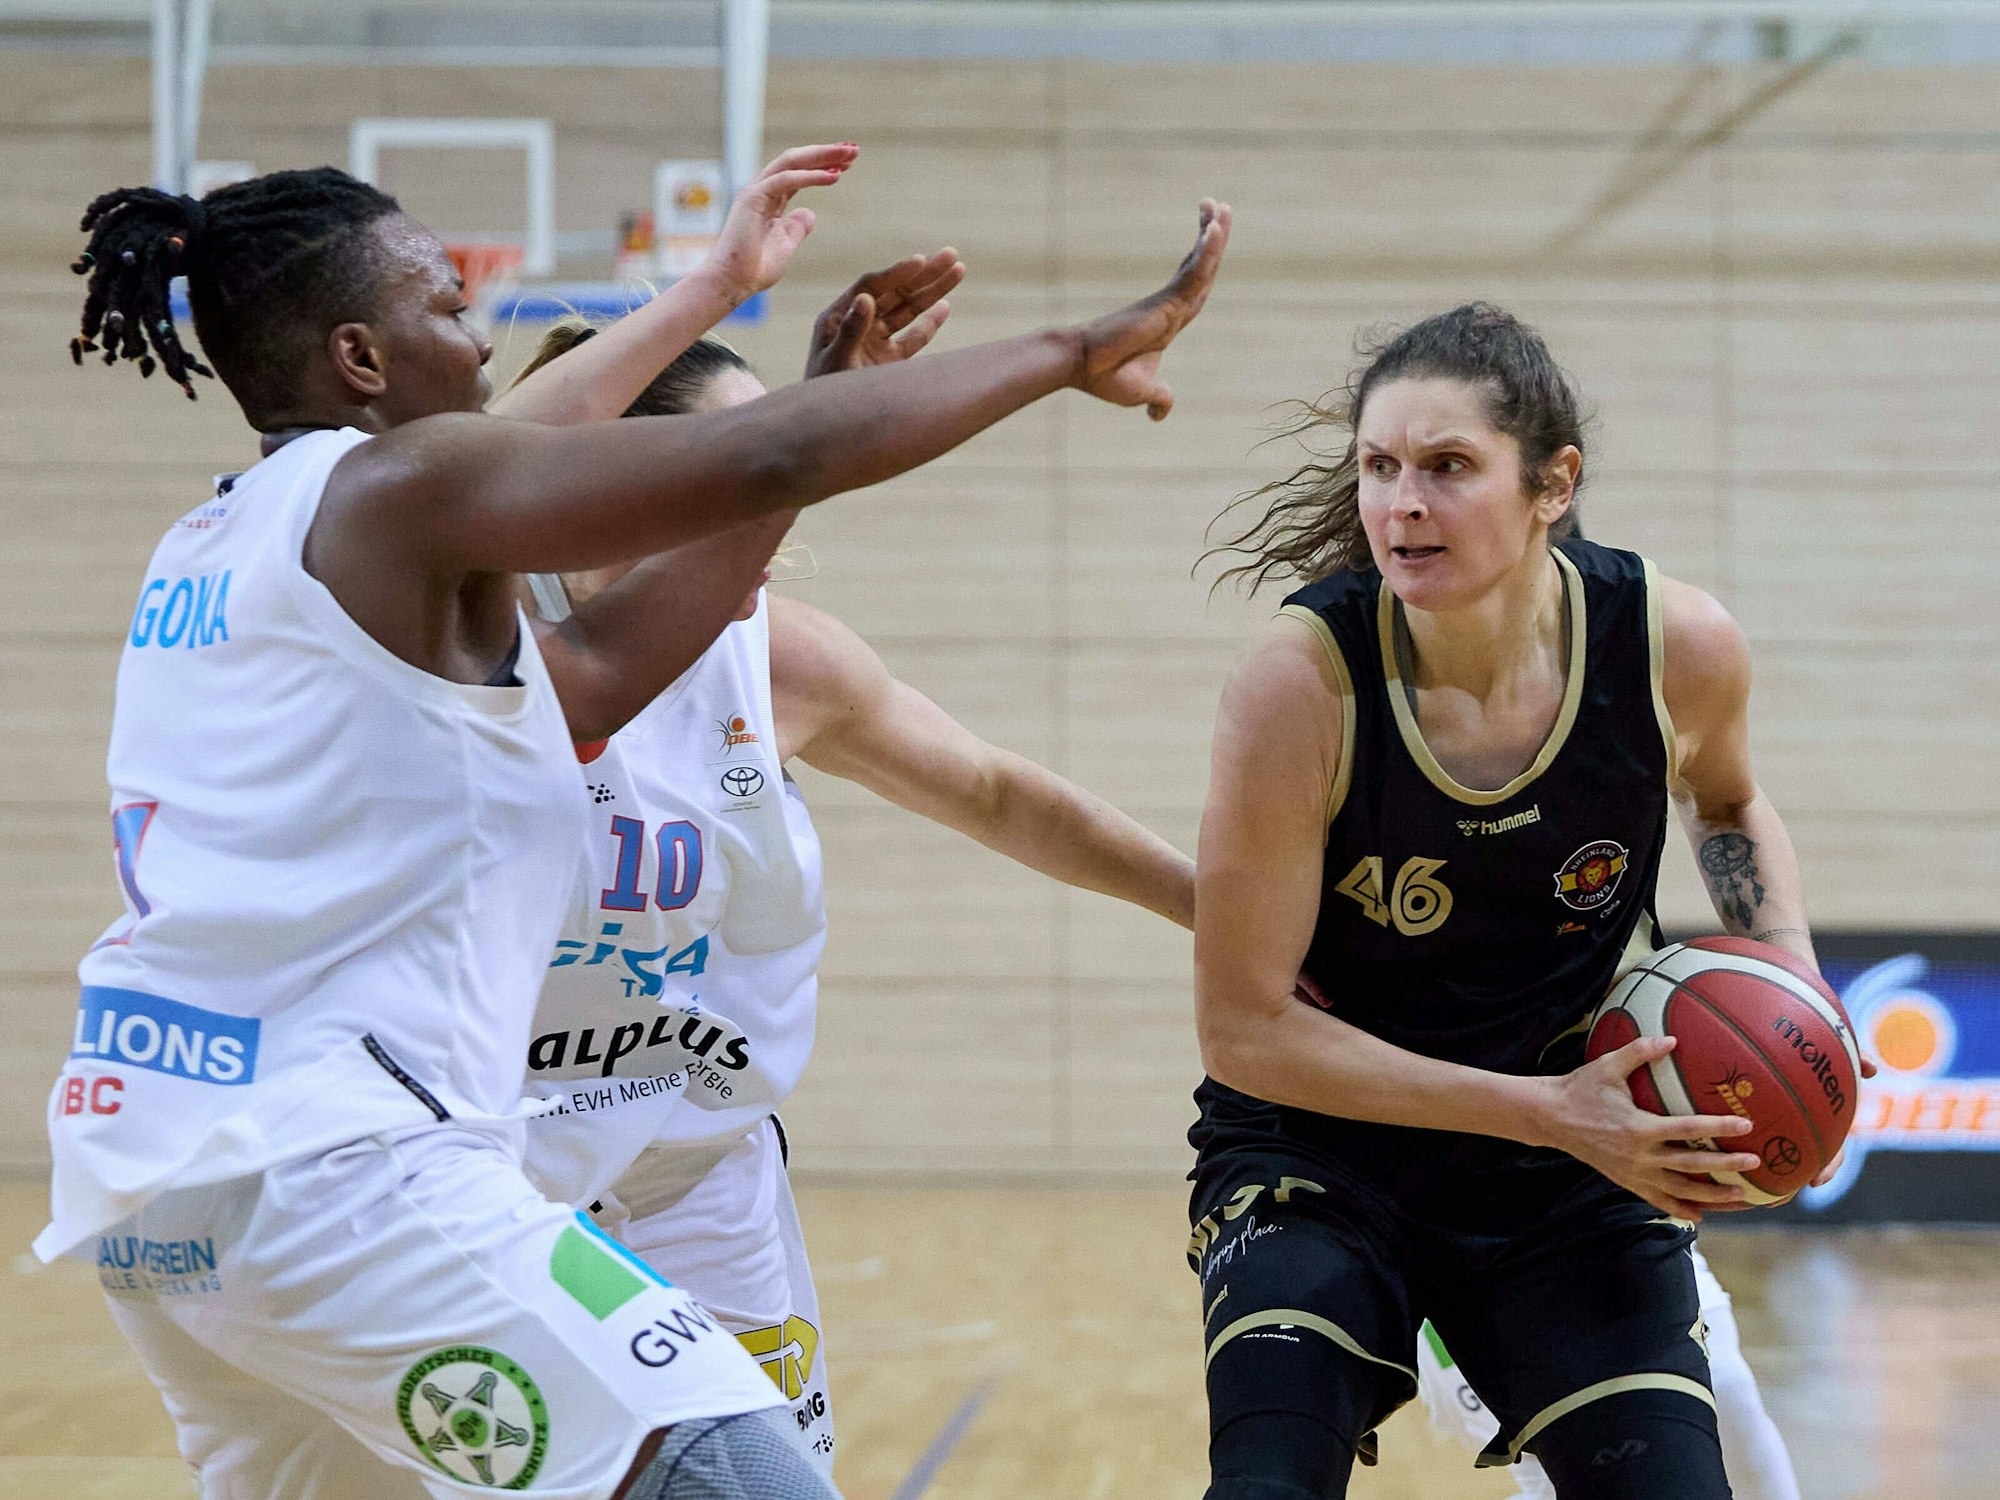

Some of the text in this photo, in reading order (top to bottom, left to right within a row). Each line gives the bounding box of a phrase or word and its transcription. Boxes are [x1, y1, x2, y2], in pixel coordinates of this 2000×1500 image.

[1480, 803, 1541, 836] hummel
[600, 814, 704, 912] 10
[1570, 847, 1616, 871] RHEINLAND
[1334, 855, 1453, 937] 46
[1577, 884, 1611, 904] LIONS
[73, 1008, 245, 1081] LIONS
[1772, 1015, 1846, 1116] molten
[56, 1076, 125, 1120] BC
[572, 1086, 614, 1113] EVH
[619, 1072, 683, 1103] Meine
